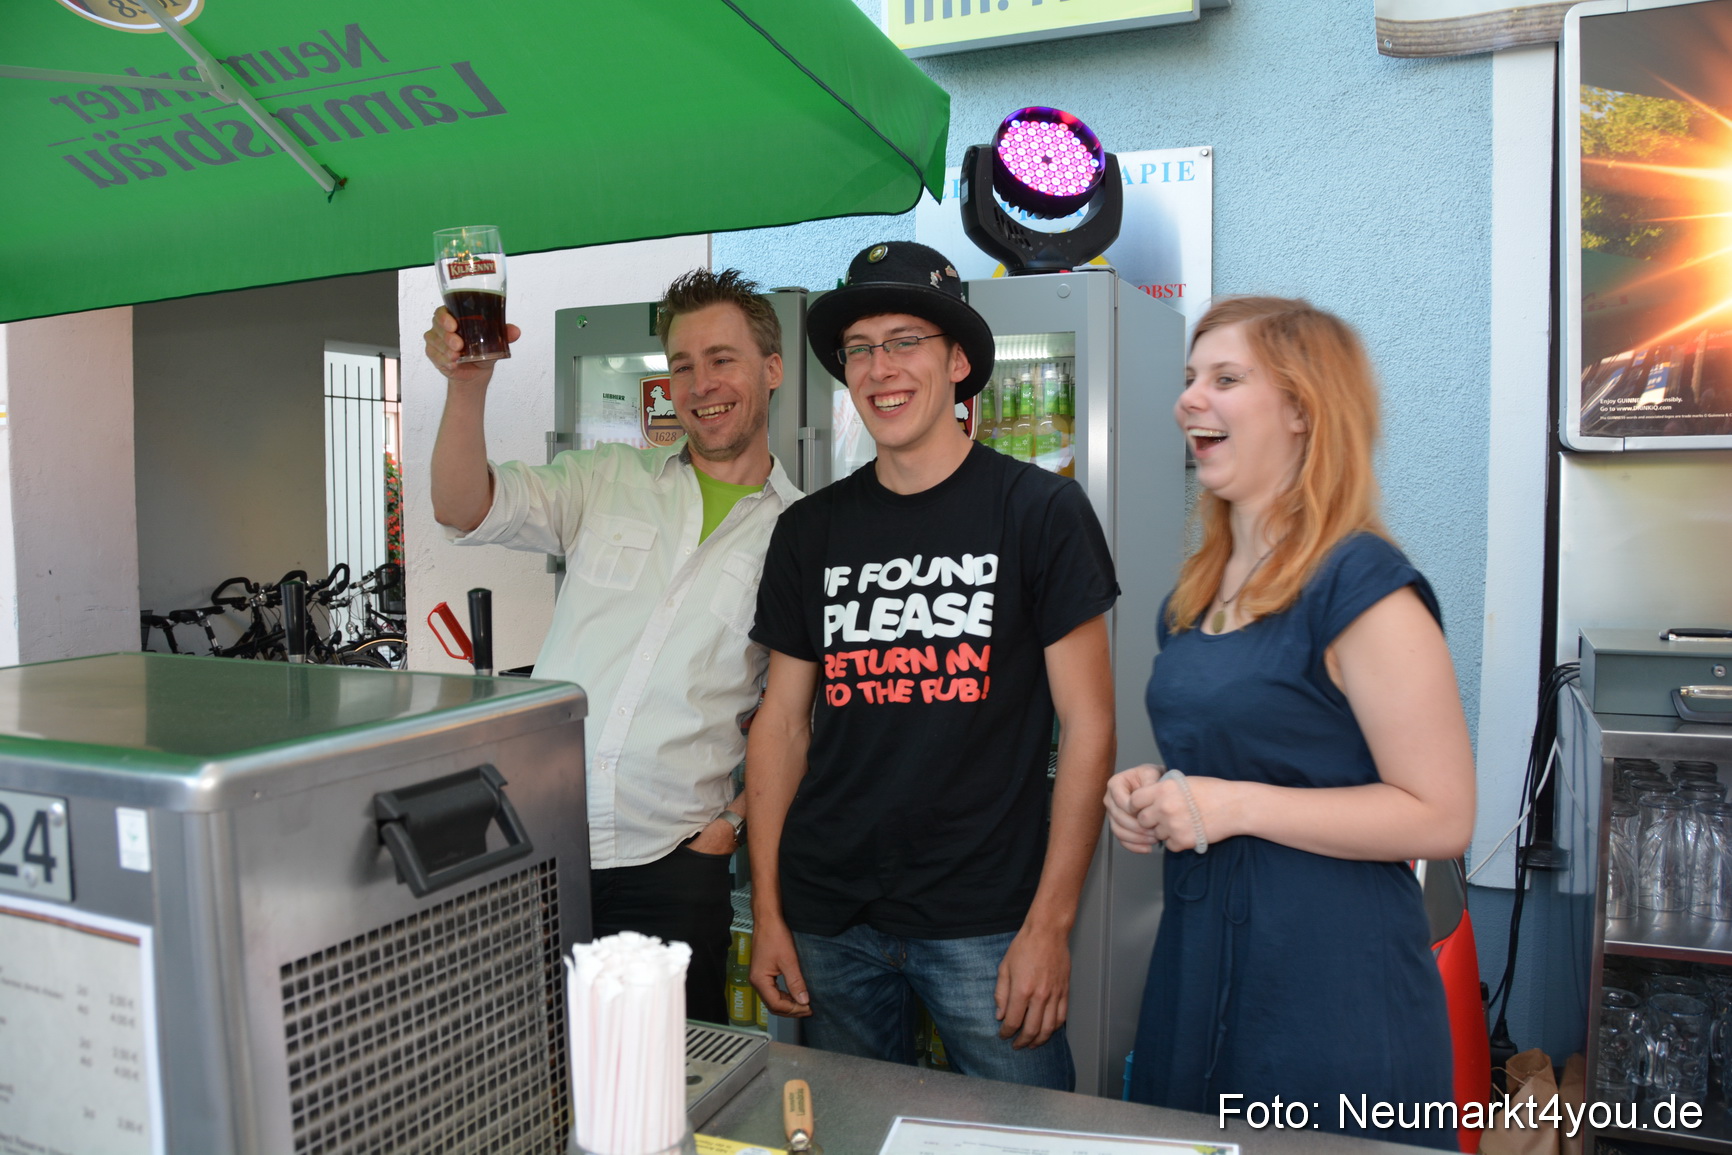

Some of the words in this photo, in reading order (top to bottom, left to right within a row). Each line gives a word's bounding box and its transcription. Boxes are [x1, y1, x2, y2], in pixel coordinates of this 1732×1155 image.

[655, 431, 677, 442] 1628
[857, 553, 999, 594] FOUND
[824, 590, 995, 648] PLEASE
[824, 645, 939, 680] RETURN
[856, 677, 916, 705] THE
[920, 675, 991, 704] PUB!
